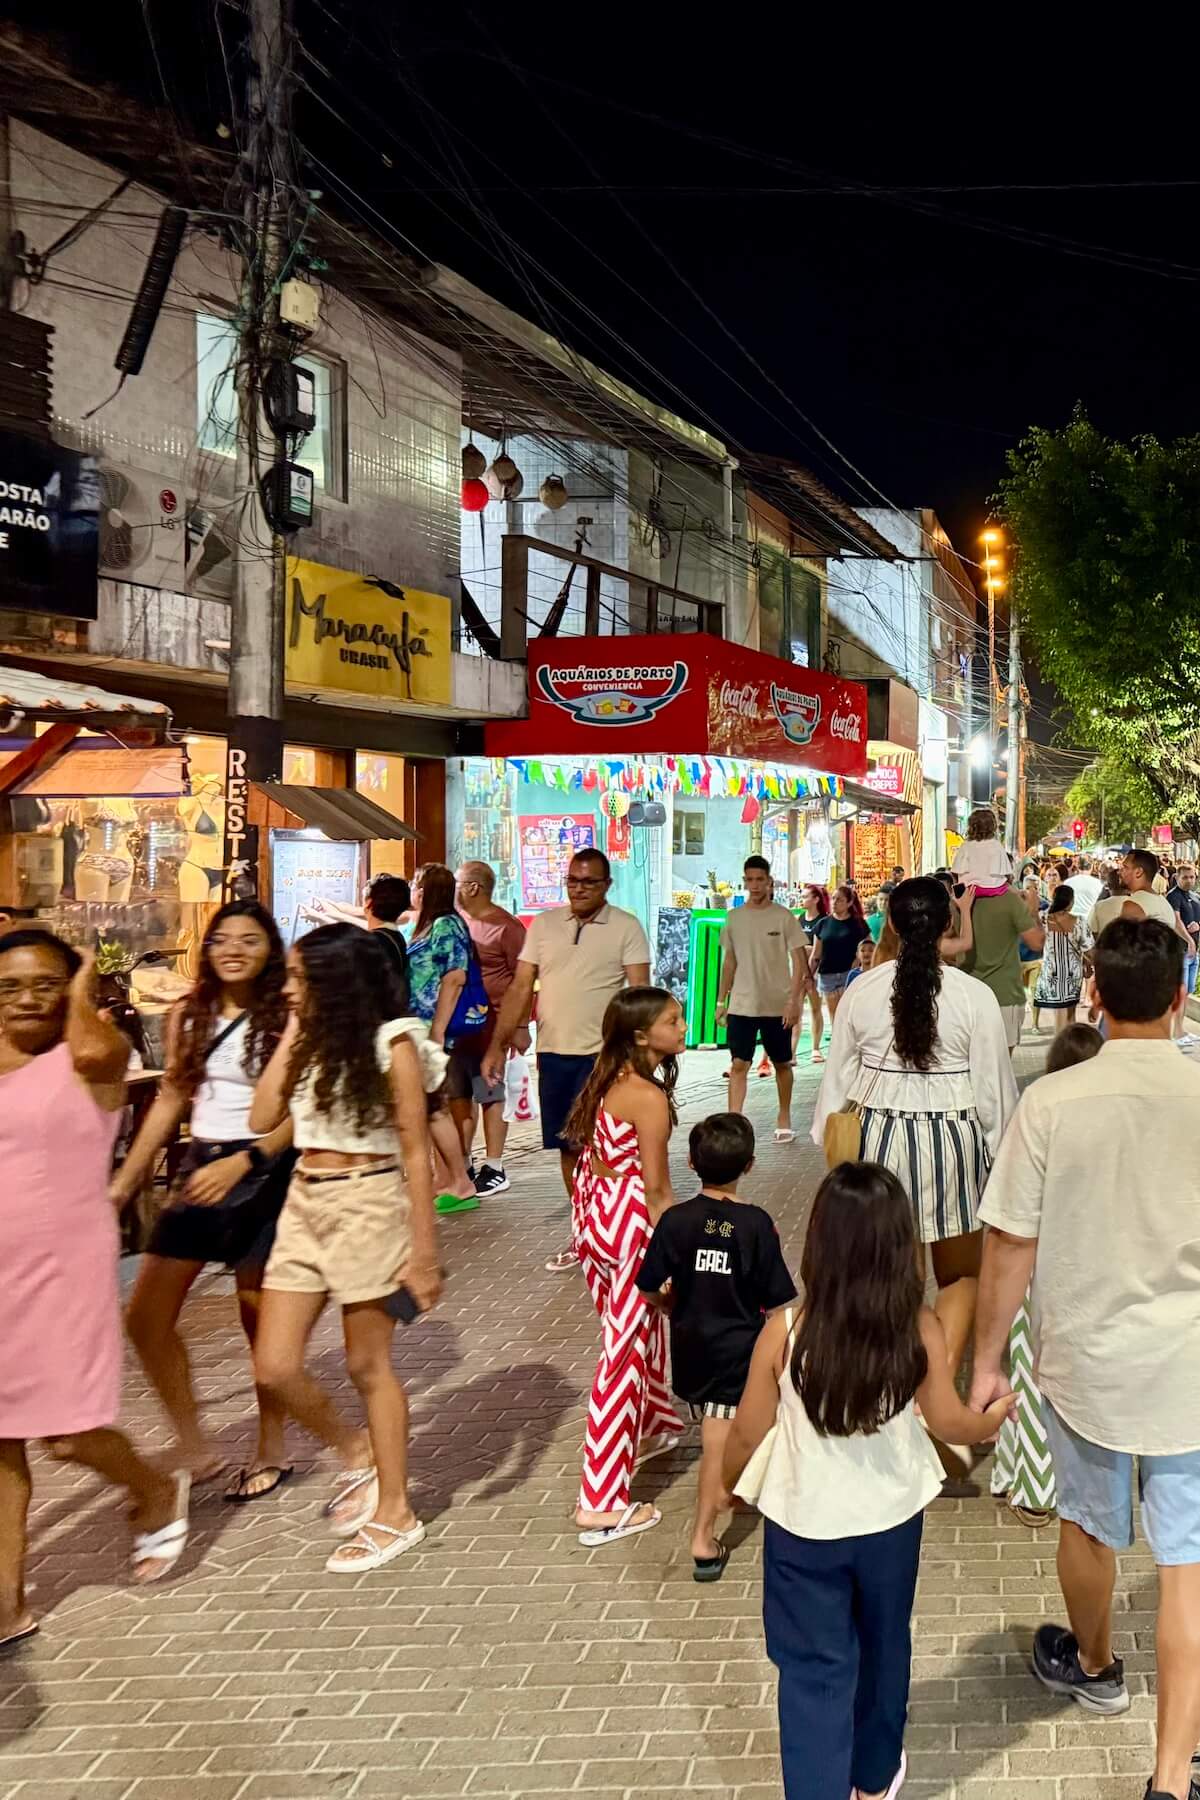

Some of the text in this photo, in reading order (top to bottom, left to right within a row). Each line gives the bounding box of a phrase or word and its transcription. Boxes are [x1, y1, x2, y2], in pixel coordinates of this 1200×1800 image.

[551, 666, 674, 682] AQUÁRIOS DE PORTO
[695, 1249, 732, 1275] GAEL
